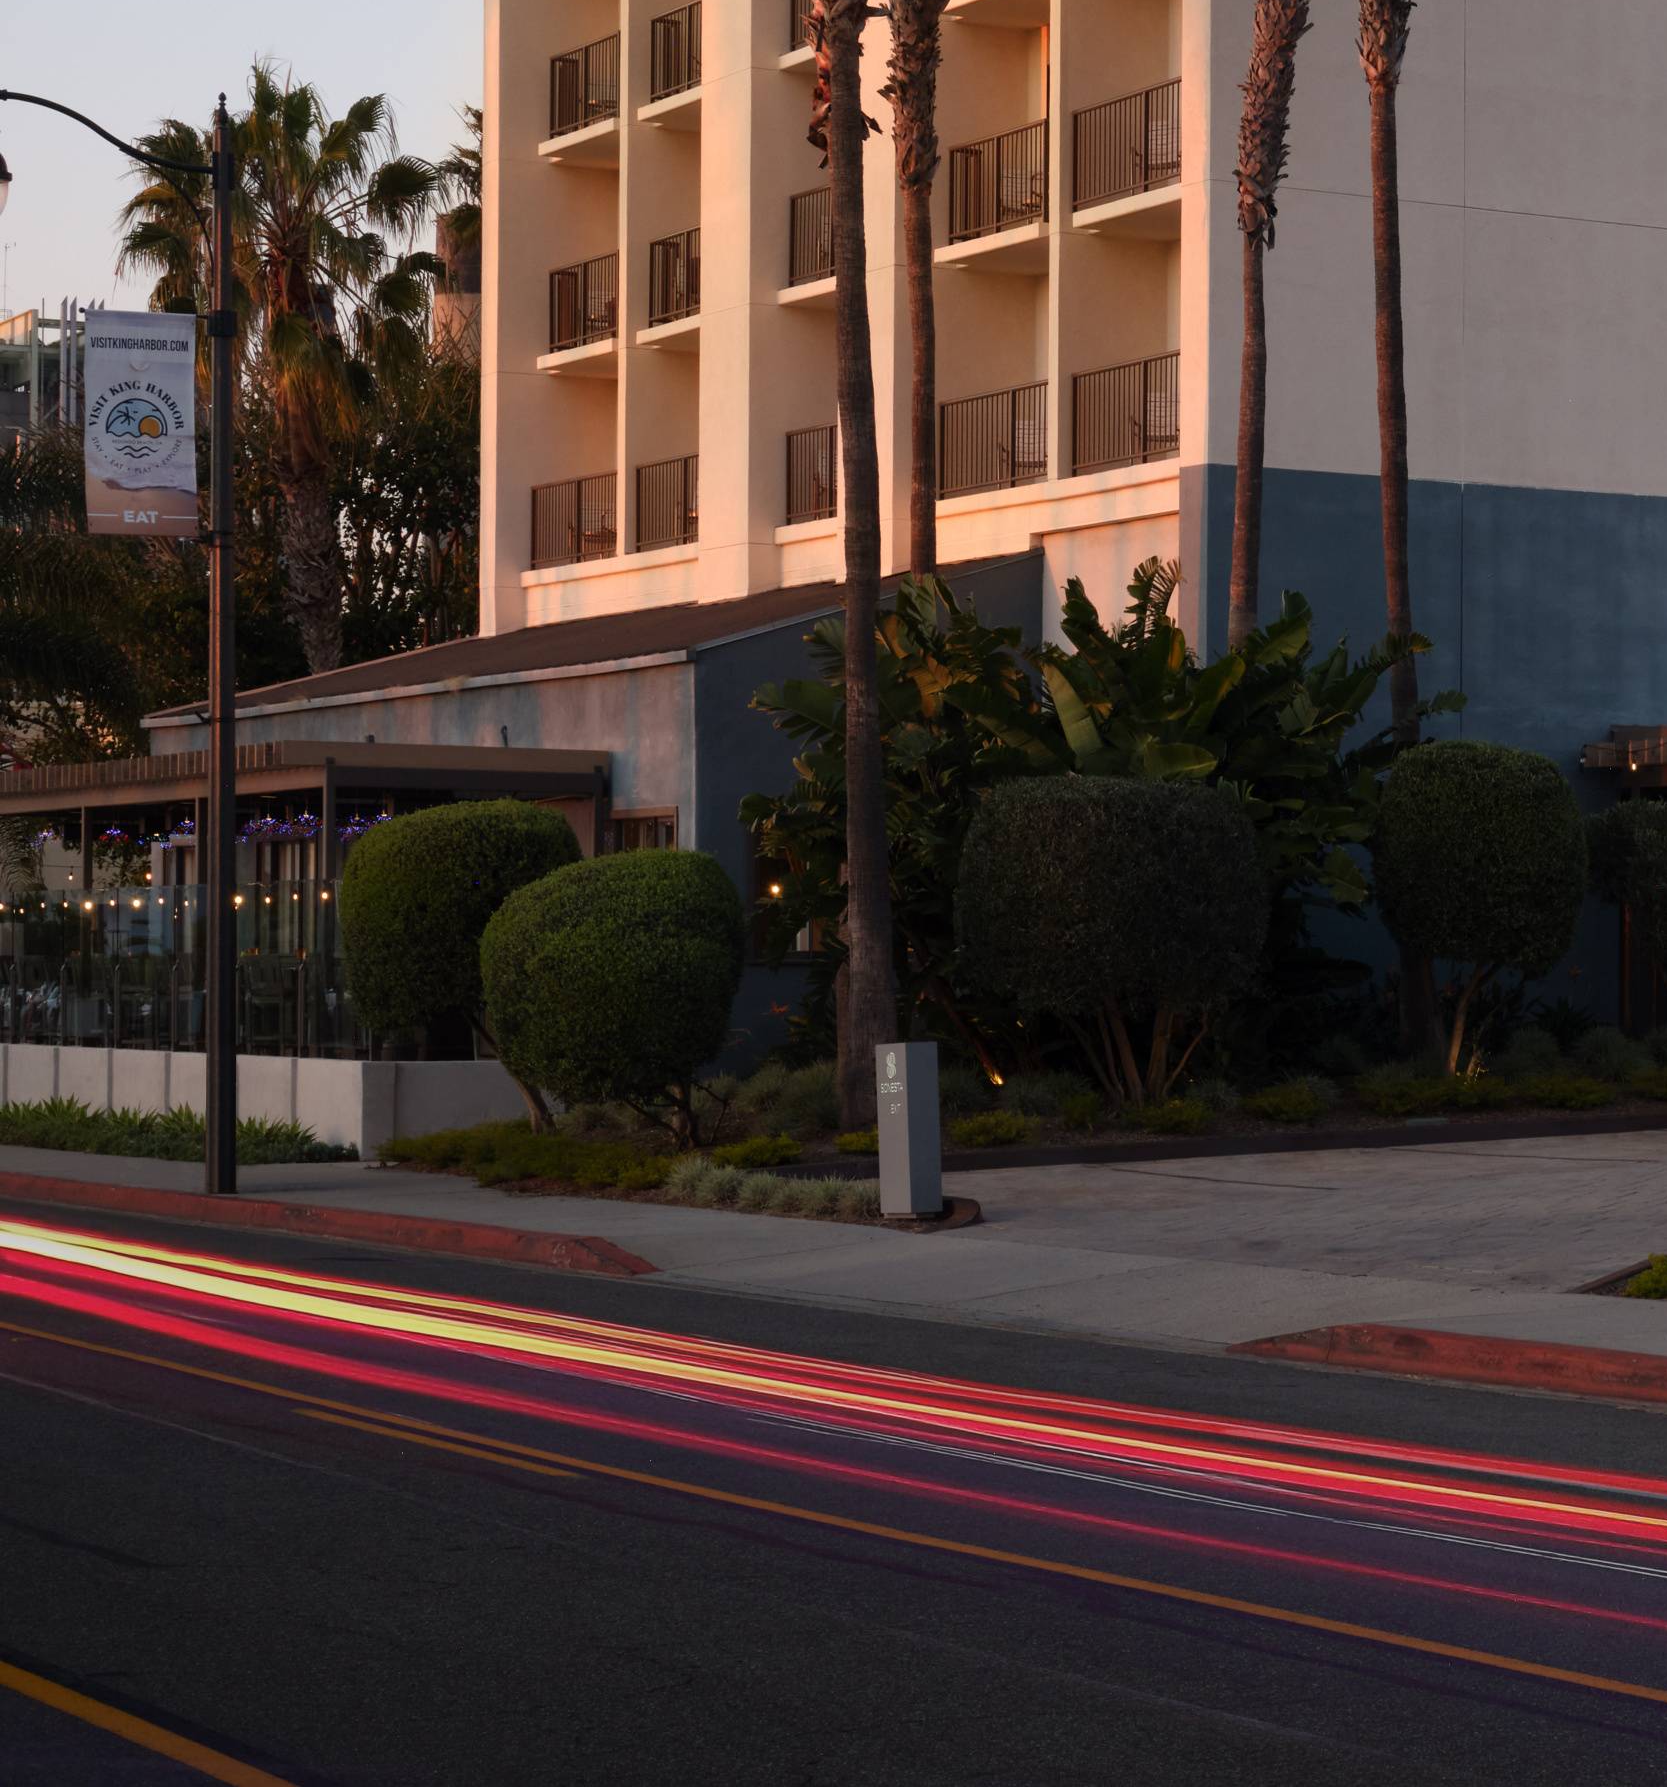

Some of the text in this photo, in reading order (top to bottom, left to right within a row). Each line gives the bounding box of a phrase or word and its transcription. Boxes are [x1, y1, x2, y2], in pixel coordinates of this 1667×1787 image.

[90, 336, 189, 353] VISITKINGHARBOR.COM
[88, 380, 185, 430] VISIT KING HARBOR
[123, 510, 159, 524] EAT
